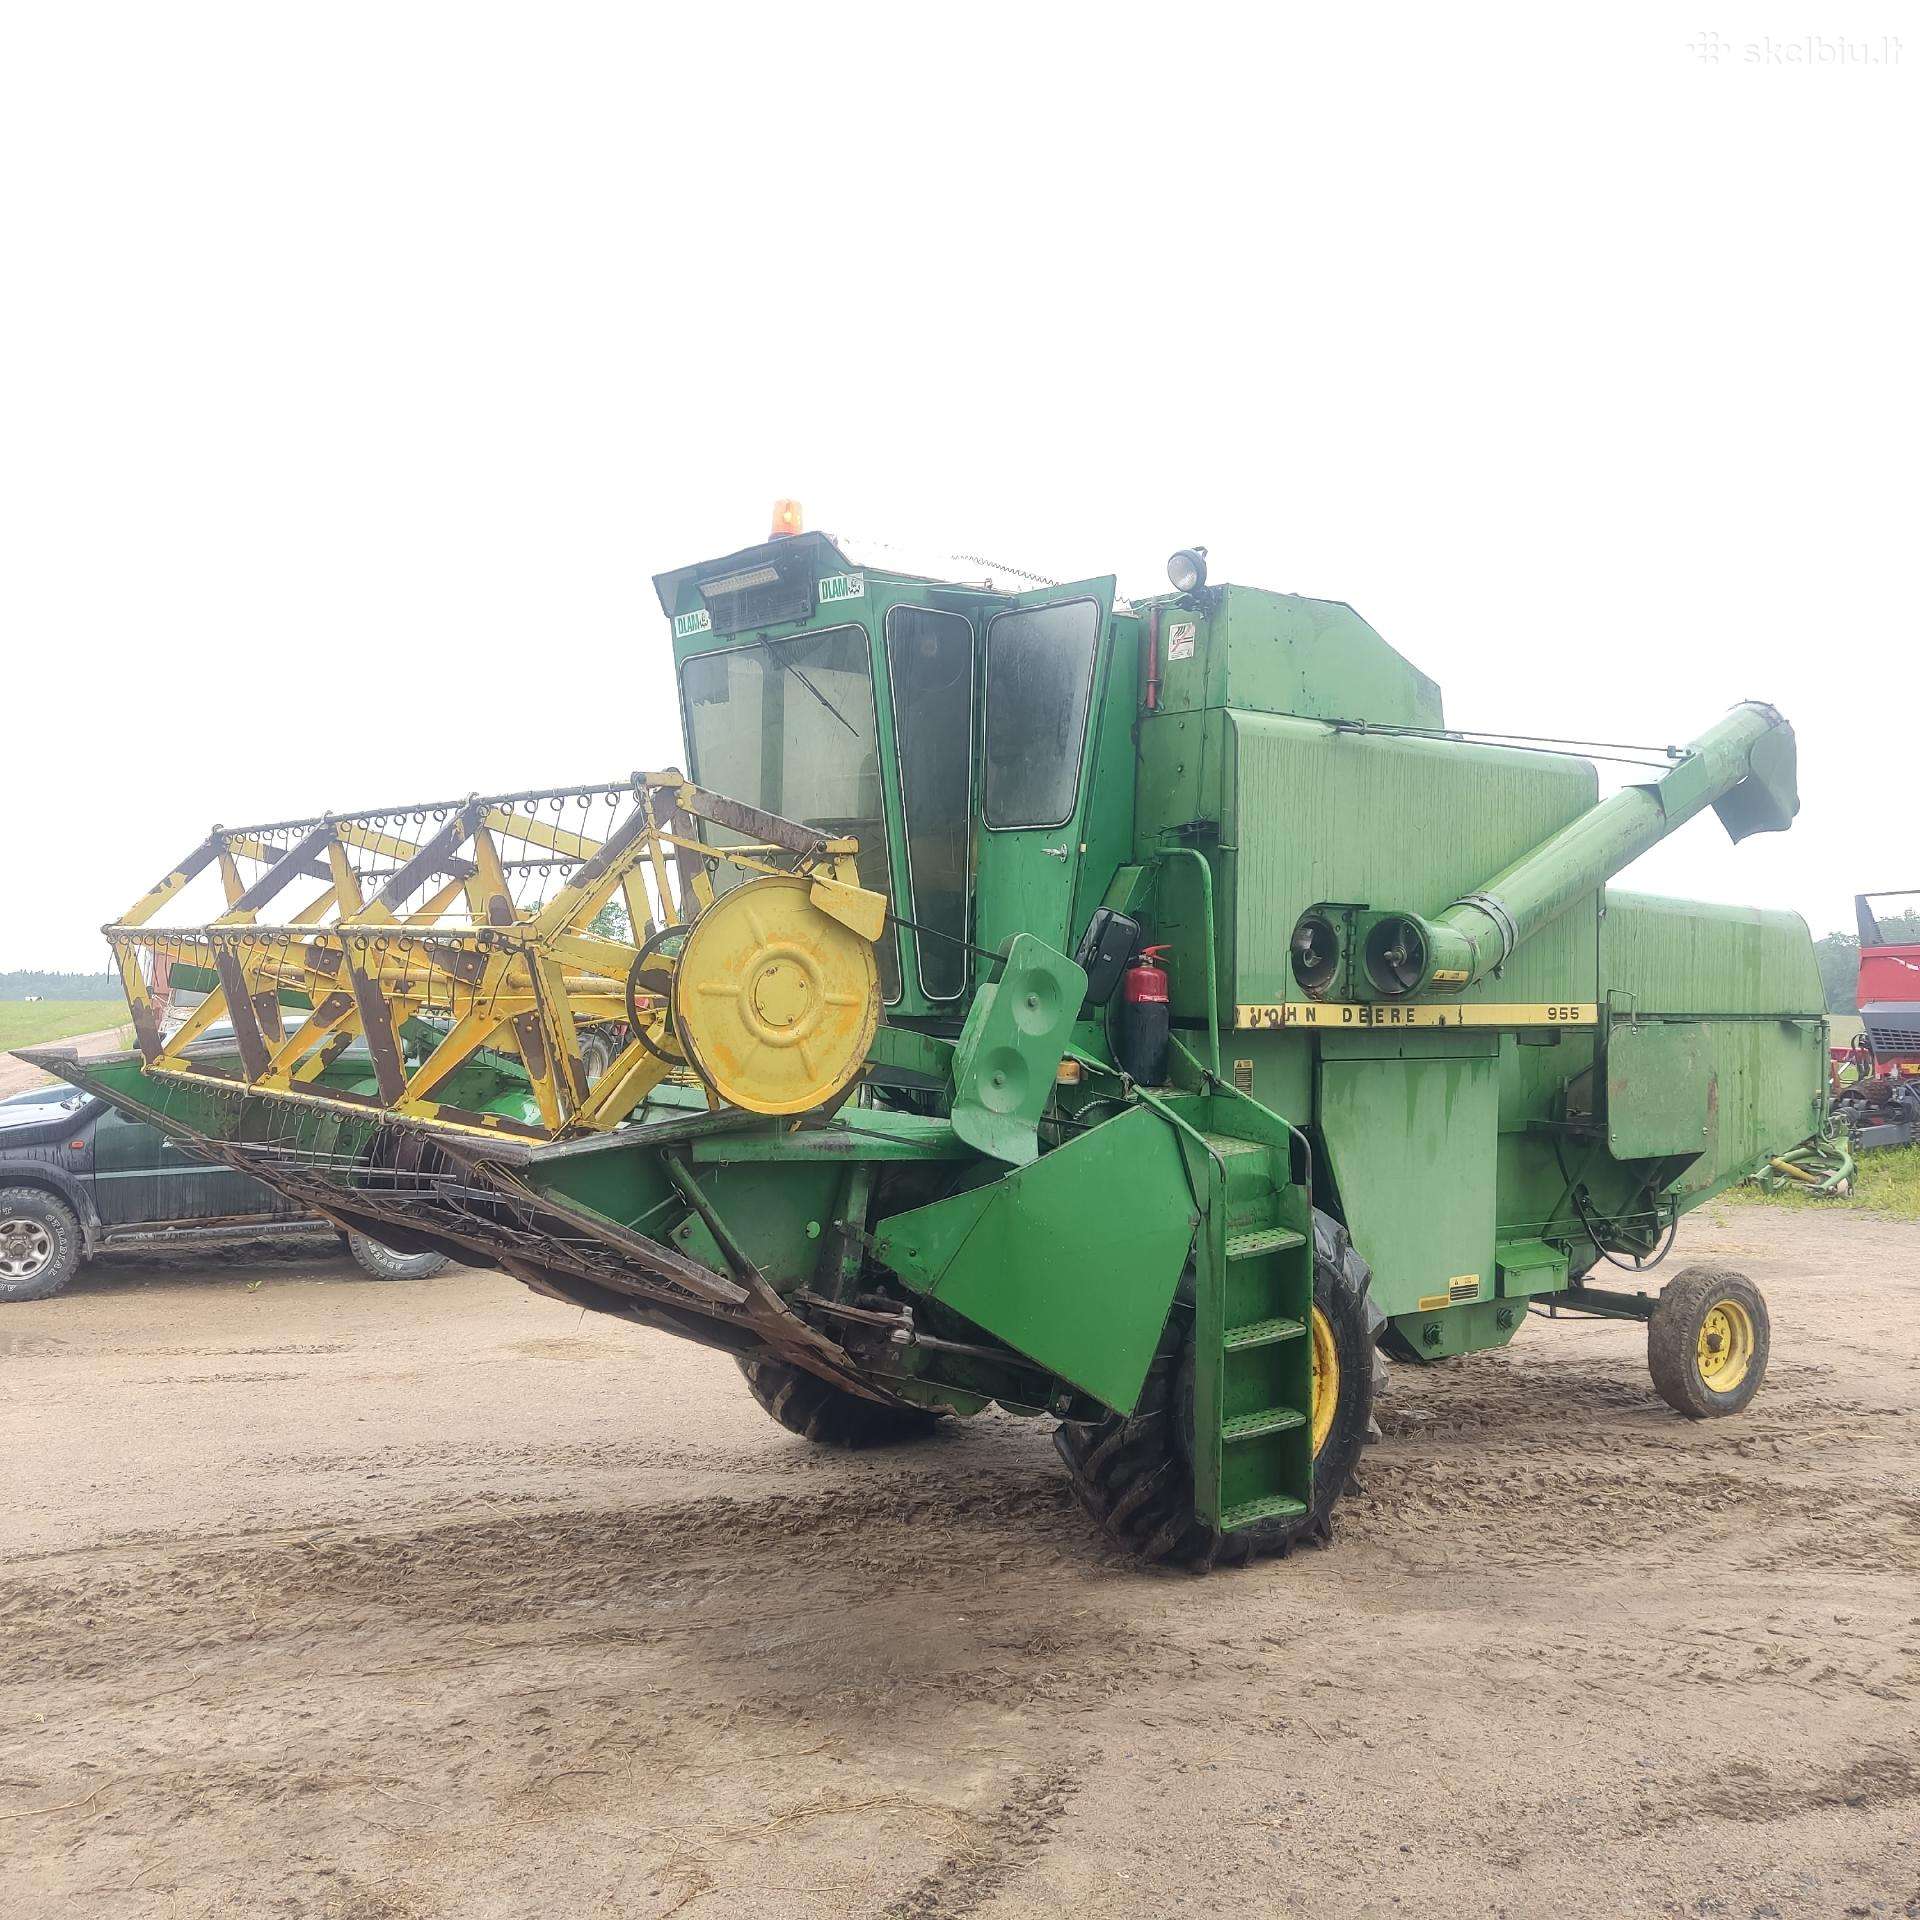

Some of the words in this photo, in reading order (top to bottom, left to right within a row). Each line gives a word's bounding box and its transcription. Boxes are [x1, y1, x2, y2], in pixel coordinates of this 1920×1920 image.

[821, 577, 848, 600] DLAM
[1251, 1006, 1317, 1025] JOHN
[1342, 1007, 1415, 1024] DEERE
[1547, 1006, 1580, 1021] 955
